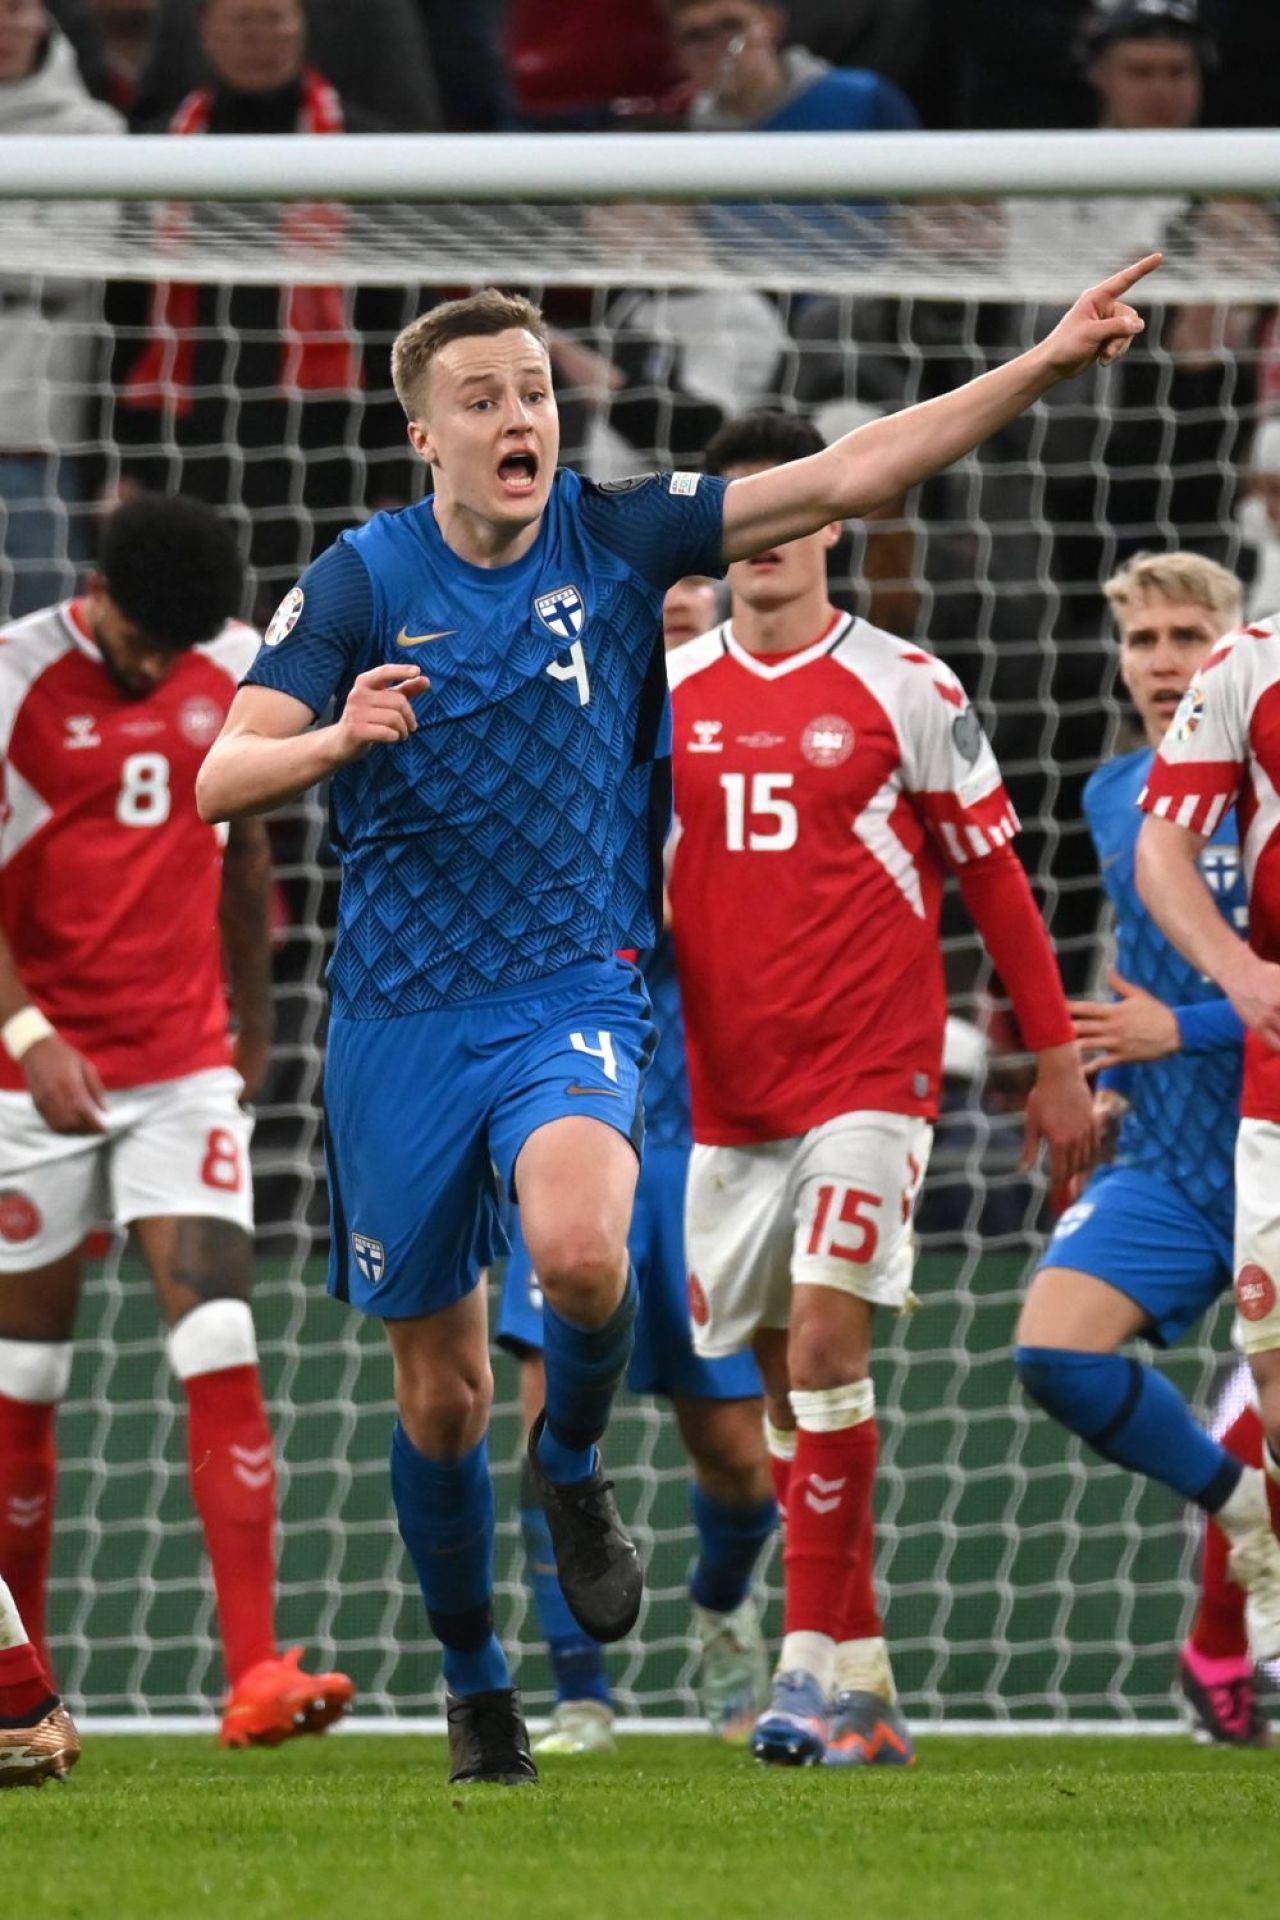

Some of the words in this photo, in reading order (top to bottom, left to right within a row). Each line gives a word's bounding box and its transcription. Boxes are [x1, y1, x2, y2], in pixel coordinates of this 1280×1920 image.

[545, 639, 590, 706] 4
[116, 752, 171, 827] 8
[719, 772, 798, 851] 15
[569, 1030, 618, 1084] 4
[201, 1128, 242, 1192] 8
[807, 1184, 882, 1264] 15
